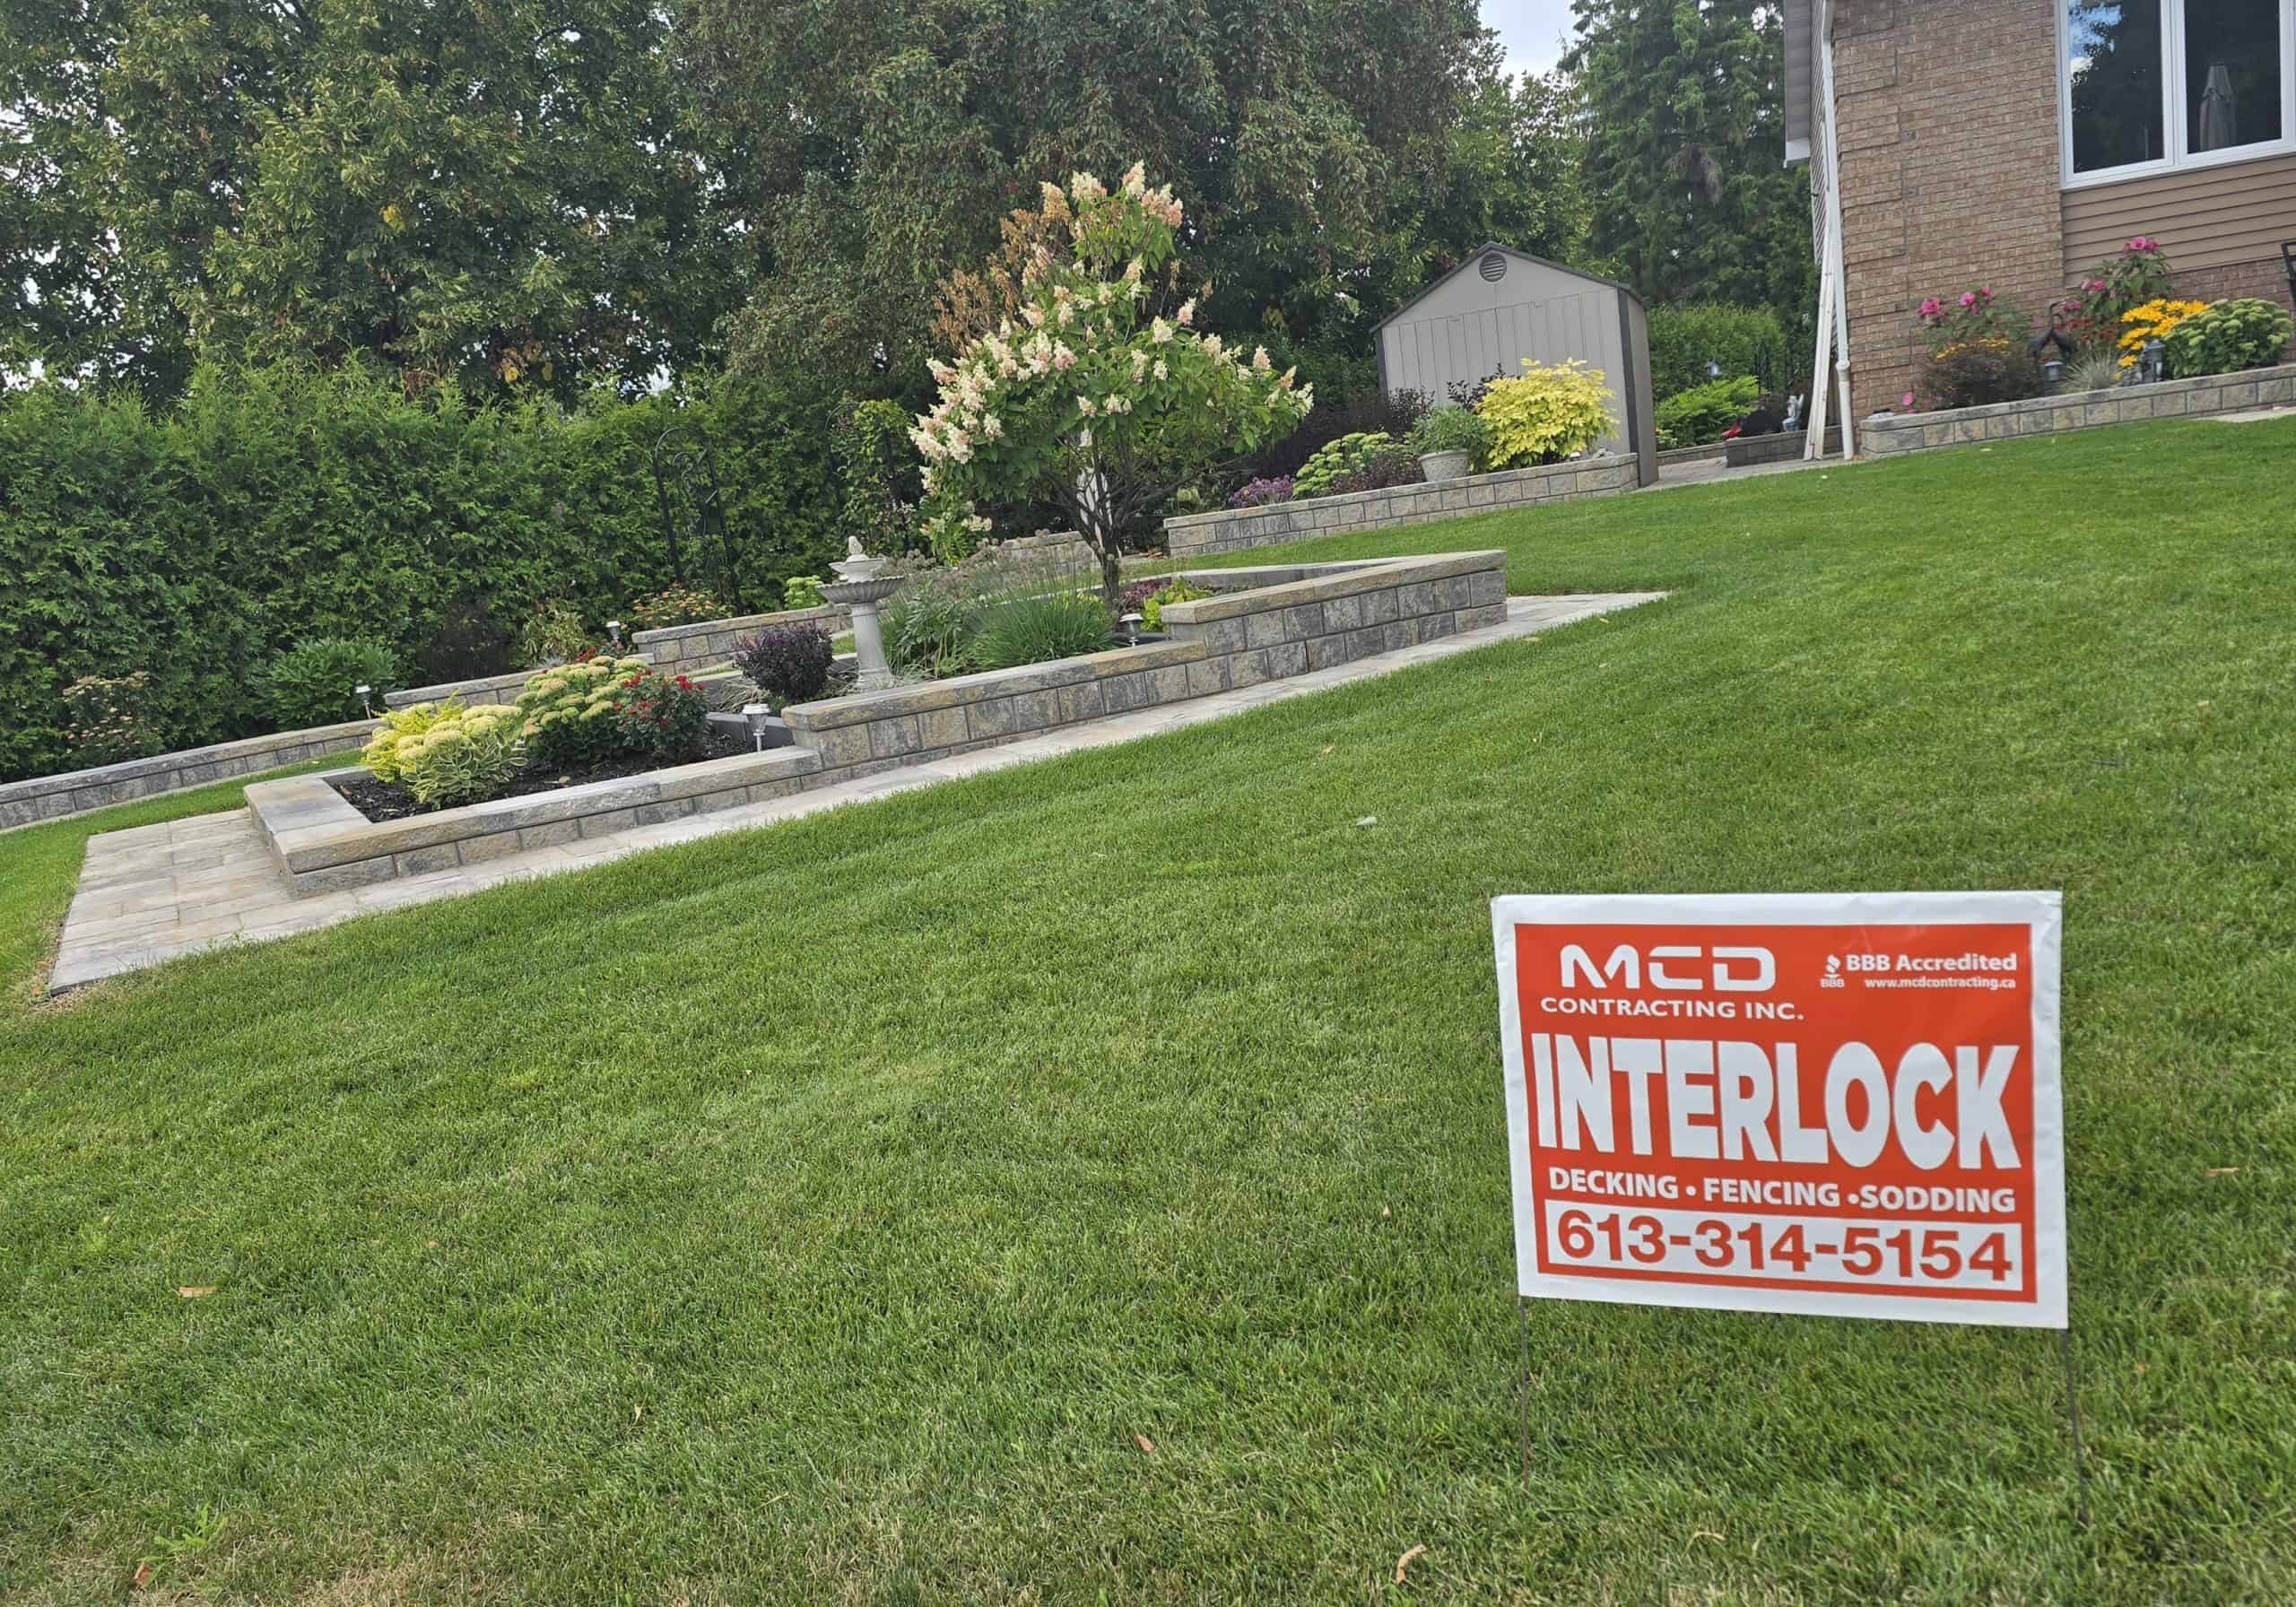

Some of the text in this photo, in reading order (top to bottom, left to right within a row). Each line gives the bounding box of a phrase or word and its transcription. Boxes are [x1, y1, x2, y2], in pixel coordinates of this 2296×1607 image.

[1560, 943, 1777, 992] MCD
[1846, 952, 2017, 971] BBB Accredited
[1820, 978, 1845, 988] BBB
[1865, 976, 2016, 990] www.mcdcontracting.ca
[1541, 997, 1805, 1021] CONTRACTING INC.
[1532, 1033, 2022, 1170] INTERLOCK
[1549, 1167, 1679, 1200] DECKING
[1705, 1178, 1839, 1208] FENCING
[1557, 1209, 2013, 1282] 613-314-5154
